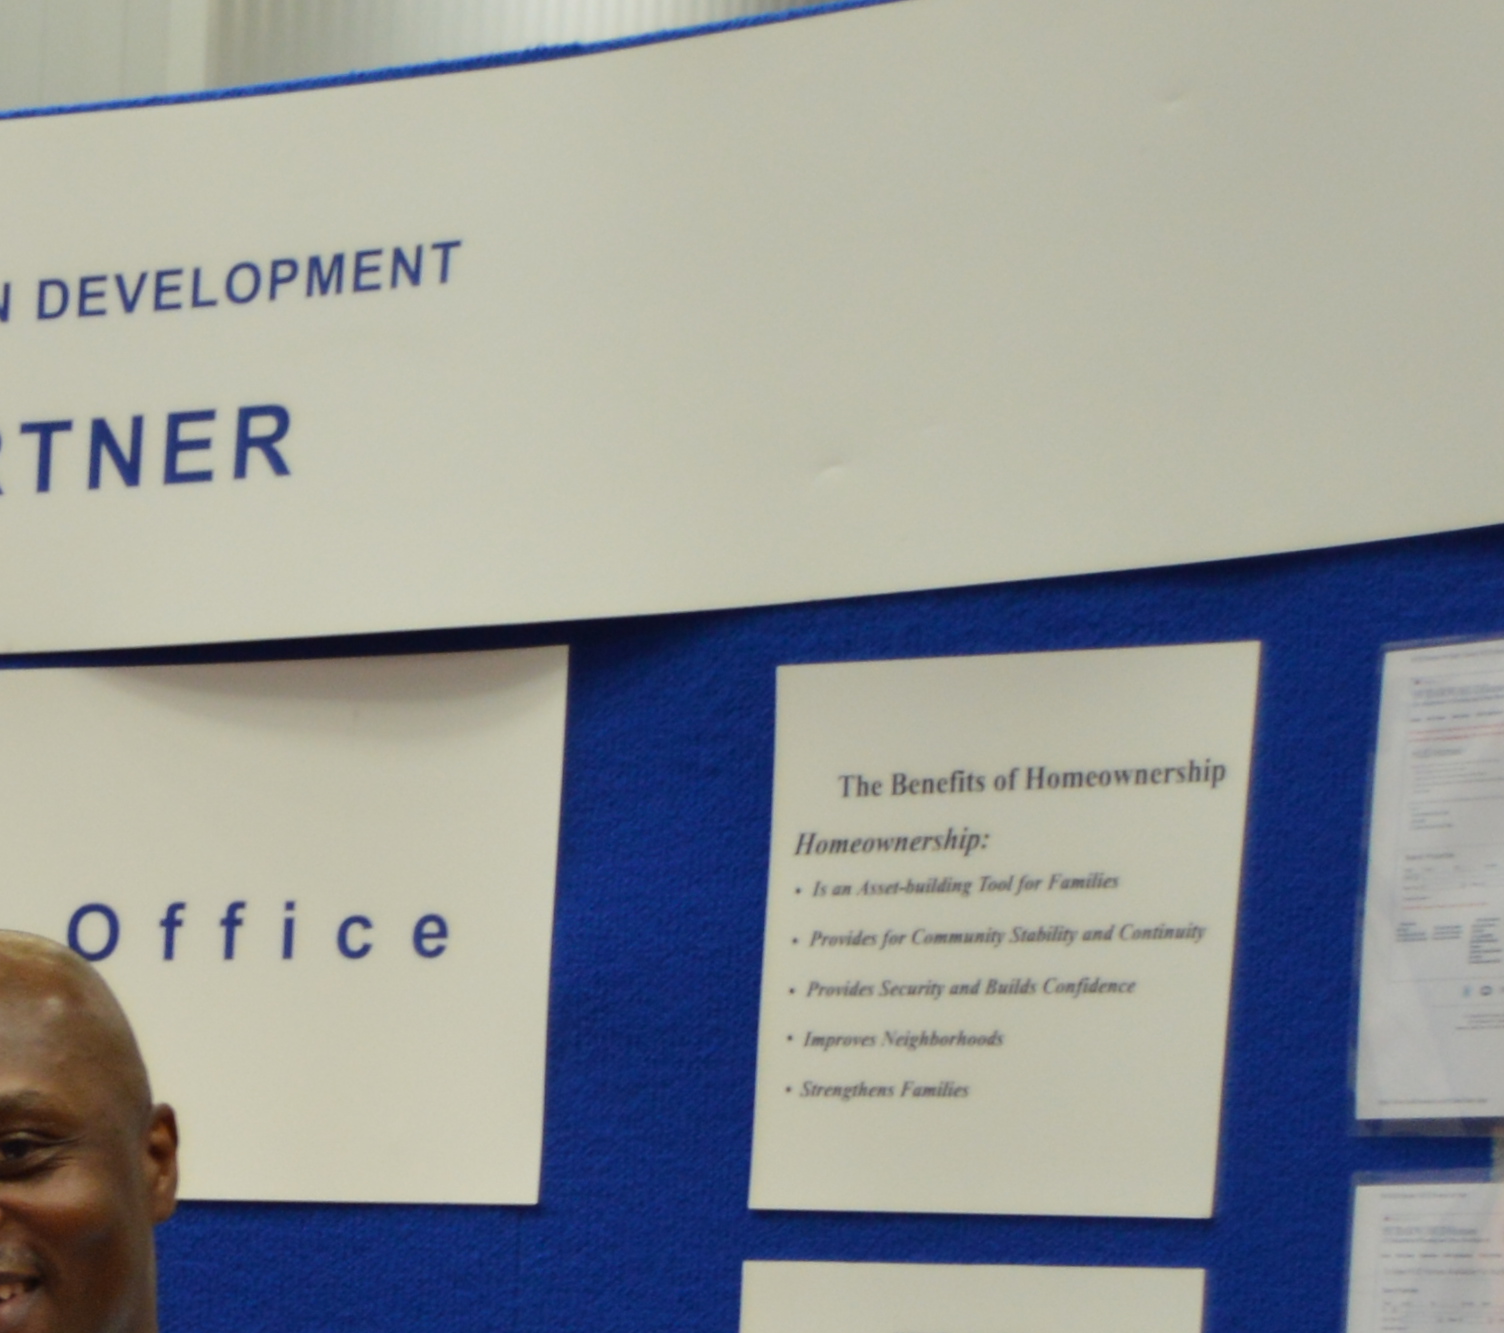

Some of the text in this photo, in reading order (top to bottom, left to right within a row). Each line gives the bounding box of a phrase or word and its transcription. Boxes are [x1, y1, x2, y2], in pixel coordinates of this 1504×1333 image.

[36, 239, 462, 321] DEVELOPMENT
[838, 758, 1227, 798] The Benefits of Homeownership
[794, 826, 990, 857] Homeownership:
[812, 872, 1119, 898] Is an Asset-building Tool for Families
[67, 900, 449, 965] Office
[809, 923, 1207, 951] Provides for Community Stability and Continuity
[806, 976, 1137, 1001] Provides Security and Builds Confidence
[803, 1029, 1004, 1052] Improves Neighborhoods
[799, 1080, 969, 1102] Strengthens Families
